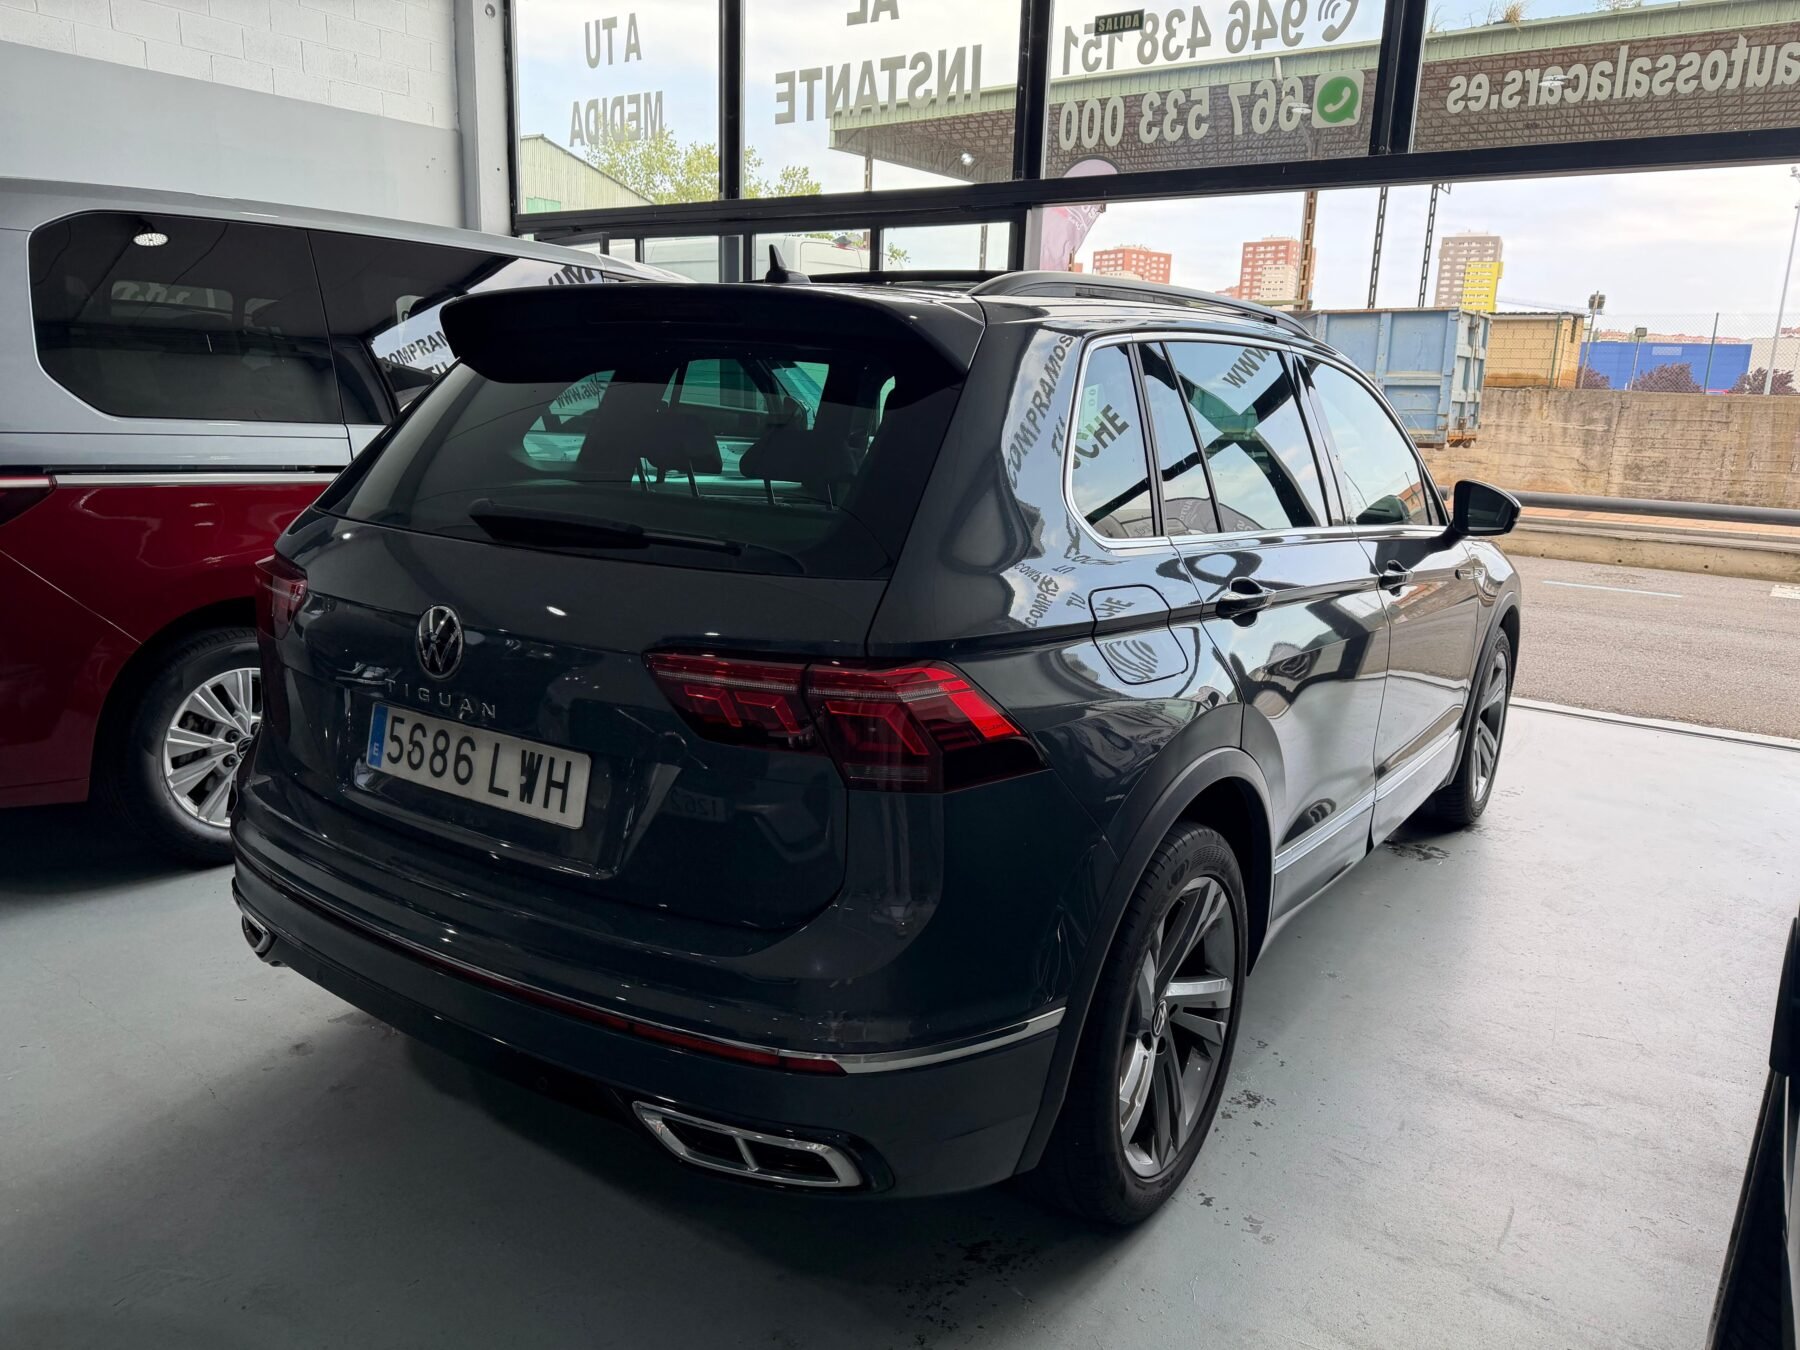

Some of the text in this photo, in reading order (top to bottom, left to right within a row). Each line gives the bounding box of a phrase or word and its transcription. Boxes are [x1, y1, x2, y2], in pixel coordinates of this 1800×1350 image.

[1098, 13, 1140, 32] SALIDA
[385, 677, 496, 719] TIGUAN
[386, 715, 477, 786] 5686
[488, 742, 572, 814] LWH
